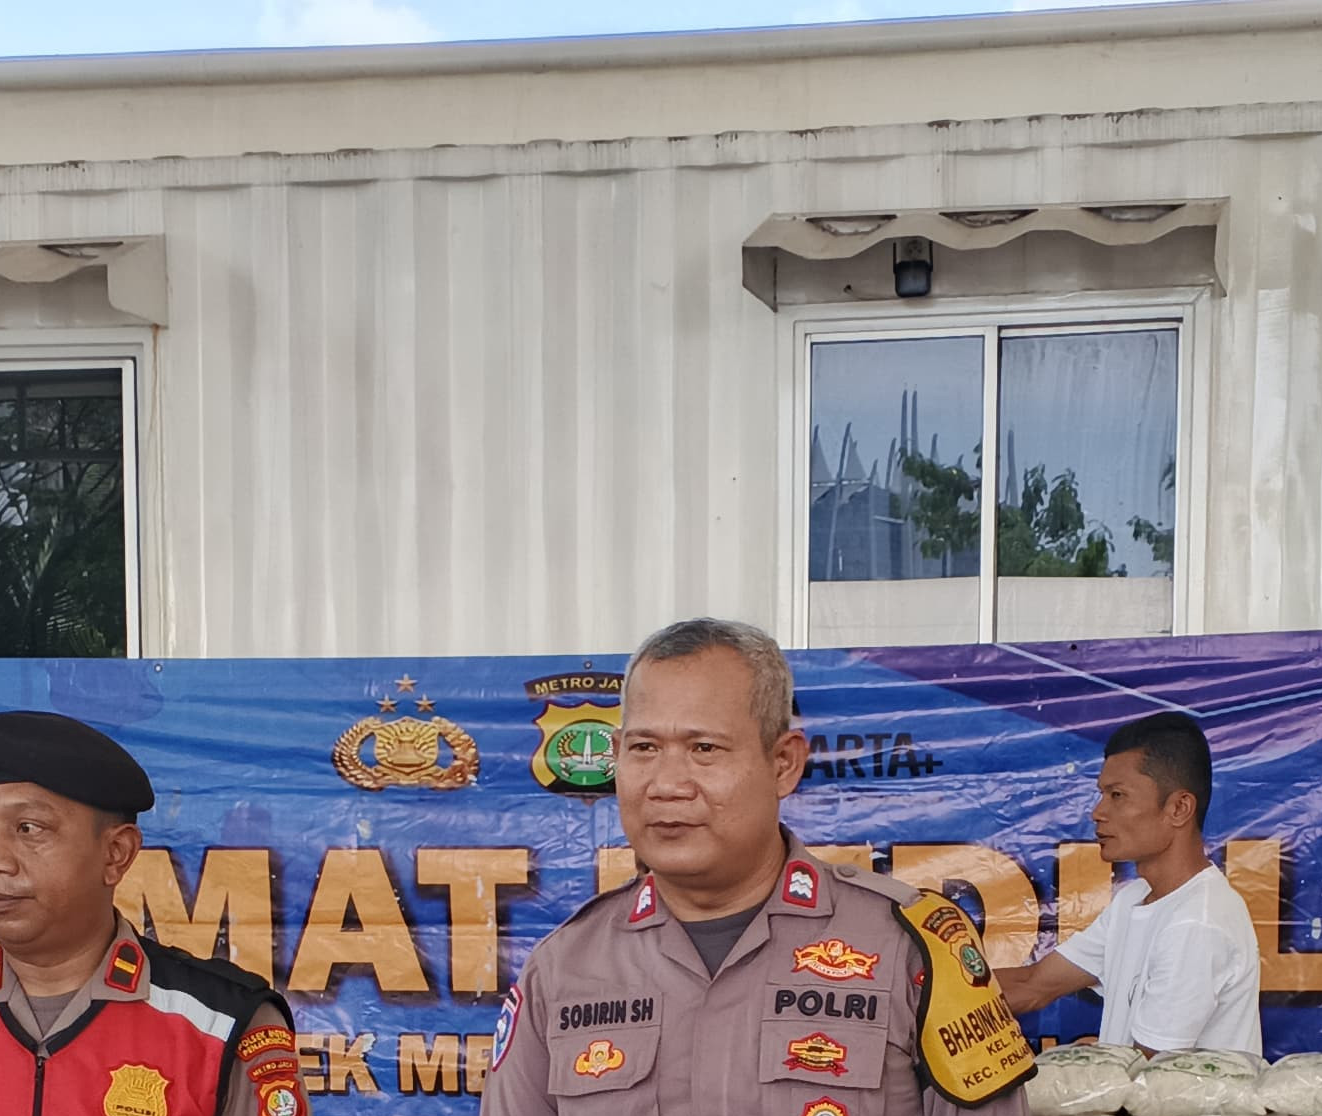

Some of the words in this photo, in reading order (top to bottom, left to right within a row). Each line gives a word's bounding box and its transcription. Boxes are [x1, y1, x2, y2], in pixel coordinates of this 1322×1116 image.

[535, 676, 595, 695] METRO
[598, 677, 626, 690] JA
[802, 732, 944, 780] ARTA+
[560, 1000, 627, 1031] SOBIRIN
[630, 997, 654, 1023] SH
[774, 989, 878, 1021] POLRI
[962, 1066, 999, 1089] KEC.
